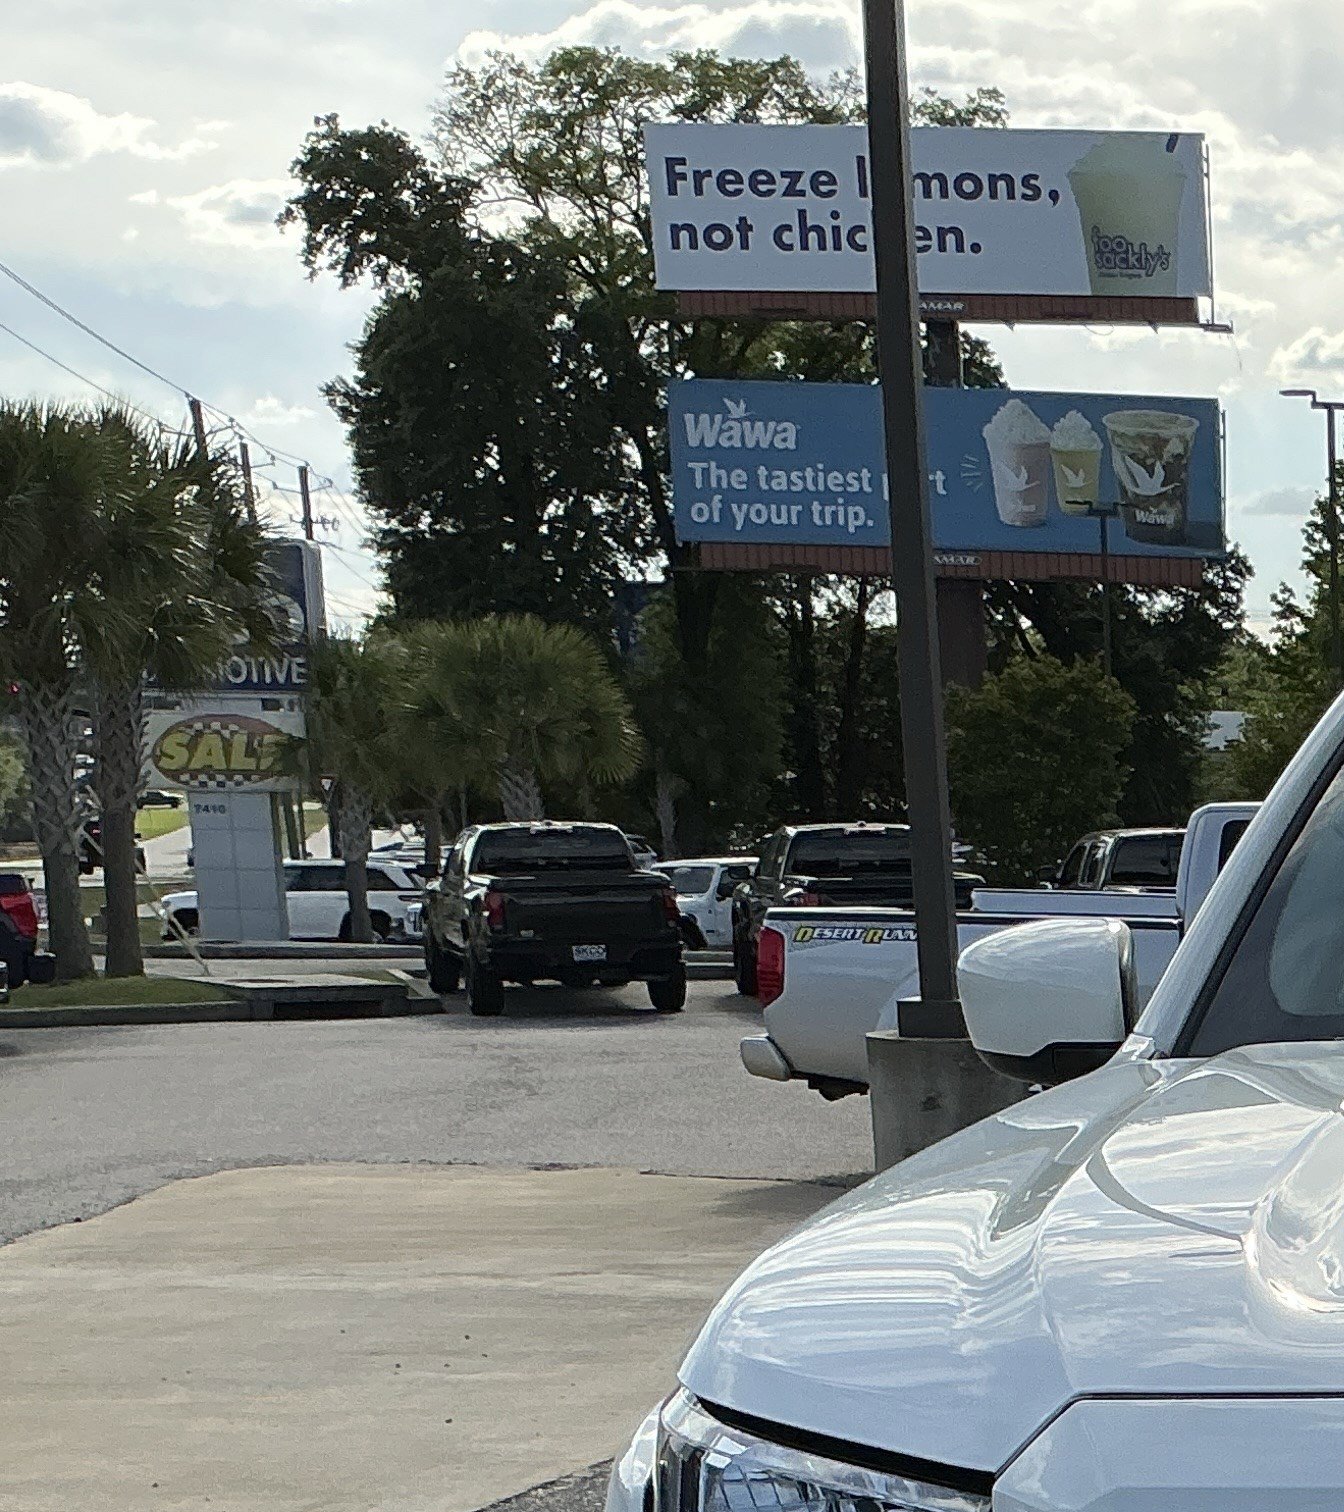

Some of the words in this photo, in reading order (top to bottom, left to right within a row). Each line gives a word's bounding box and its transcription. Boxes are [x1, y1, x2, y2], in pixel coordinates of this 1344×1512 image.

[664, 156, 838, 199] Freeze
[855, 155, 1060, 207] lmons,
[670, 215, 753, 251] not
[772, 208, 982, 255] chicen.
[683, 413, 798, 450] Wawa
[688, 462, 748, 489] The
[757, 463, 873, 494] tastiest
[690, 495, 723, 523] of
[731, 501, 803, 531] your
[811, 498, 874, 533] trip.
